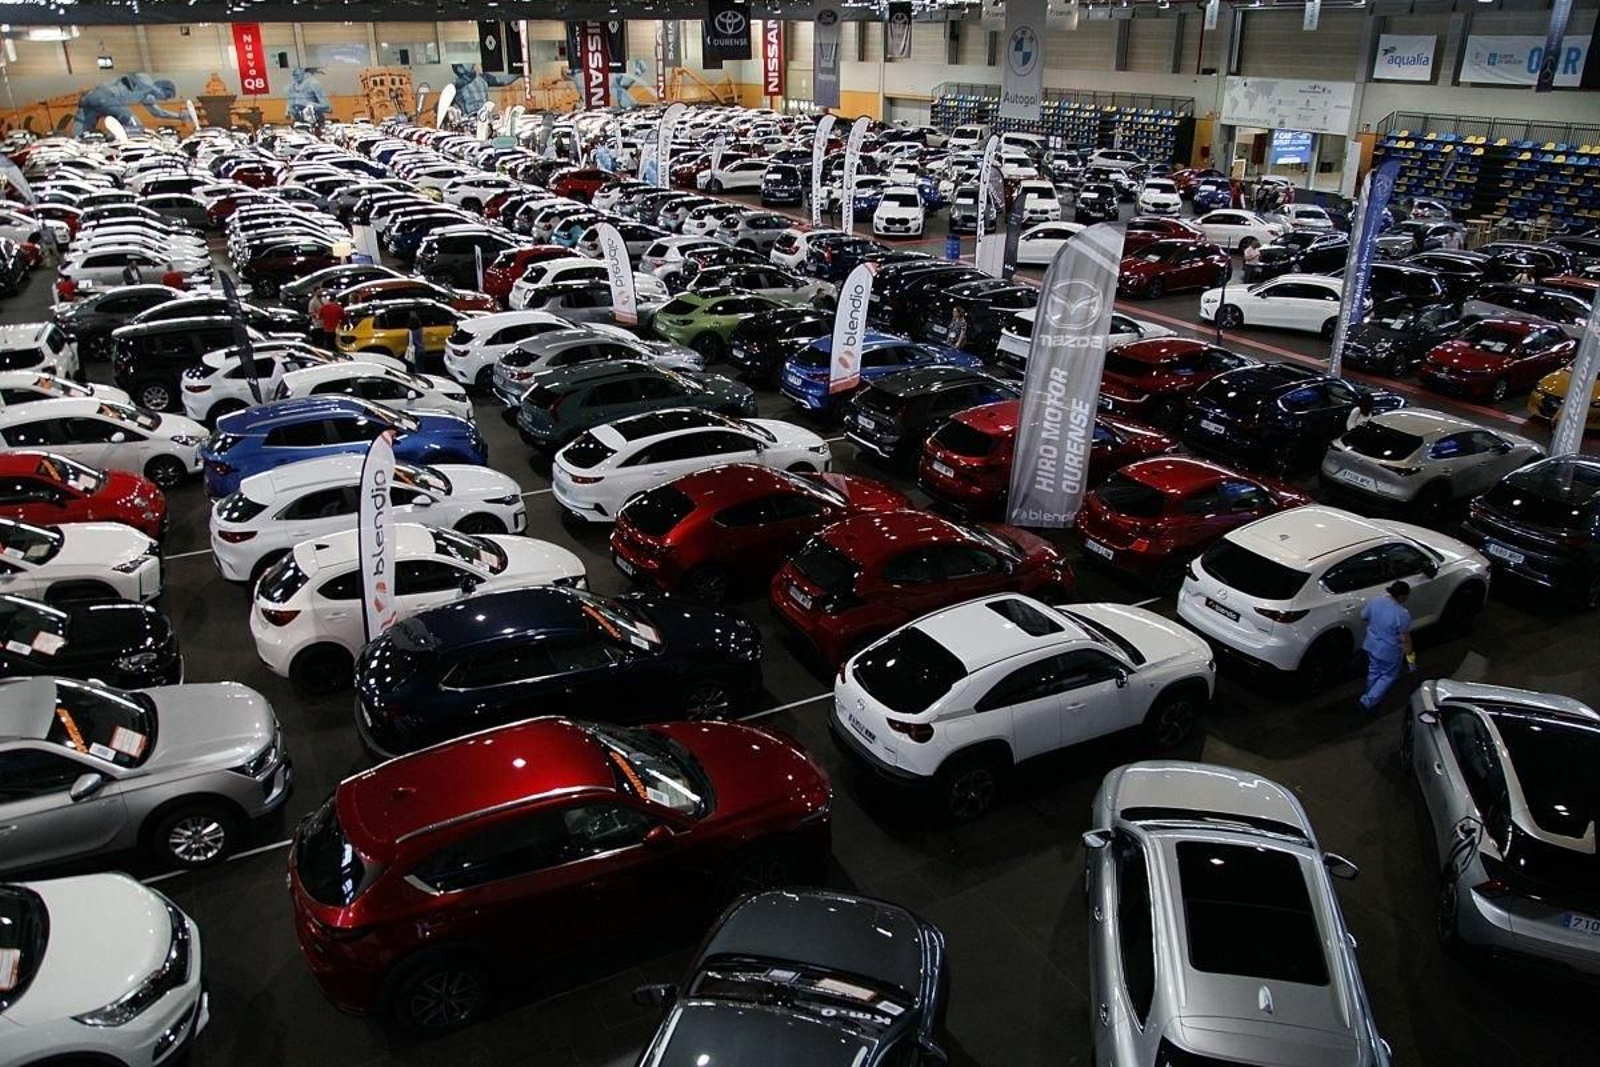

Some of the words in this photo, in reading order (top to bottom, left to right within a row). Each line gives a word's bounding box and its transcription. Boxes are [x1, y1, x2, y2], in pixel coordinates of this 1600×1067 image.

[244, 78, 265, 90] Q8
[1003, 91, 1038, 107] Autogal
[843, 284, 865, 347] blendio
[1041, 366, 1068, 438] MOTOR
[1035, 439, 1058, 493] HIRO
[1061, 399, 1090, 495] OURENSE
[370, 469, 387, 577] blendio
